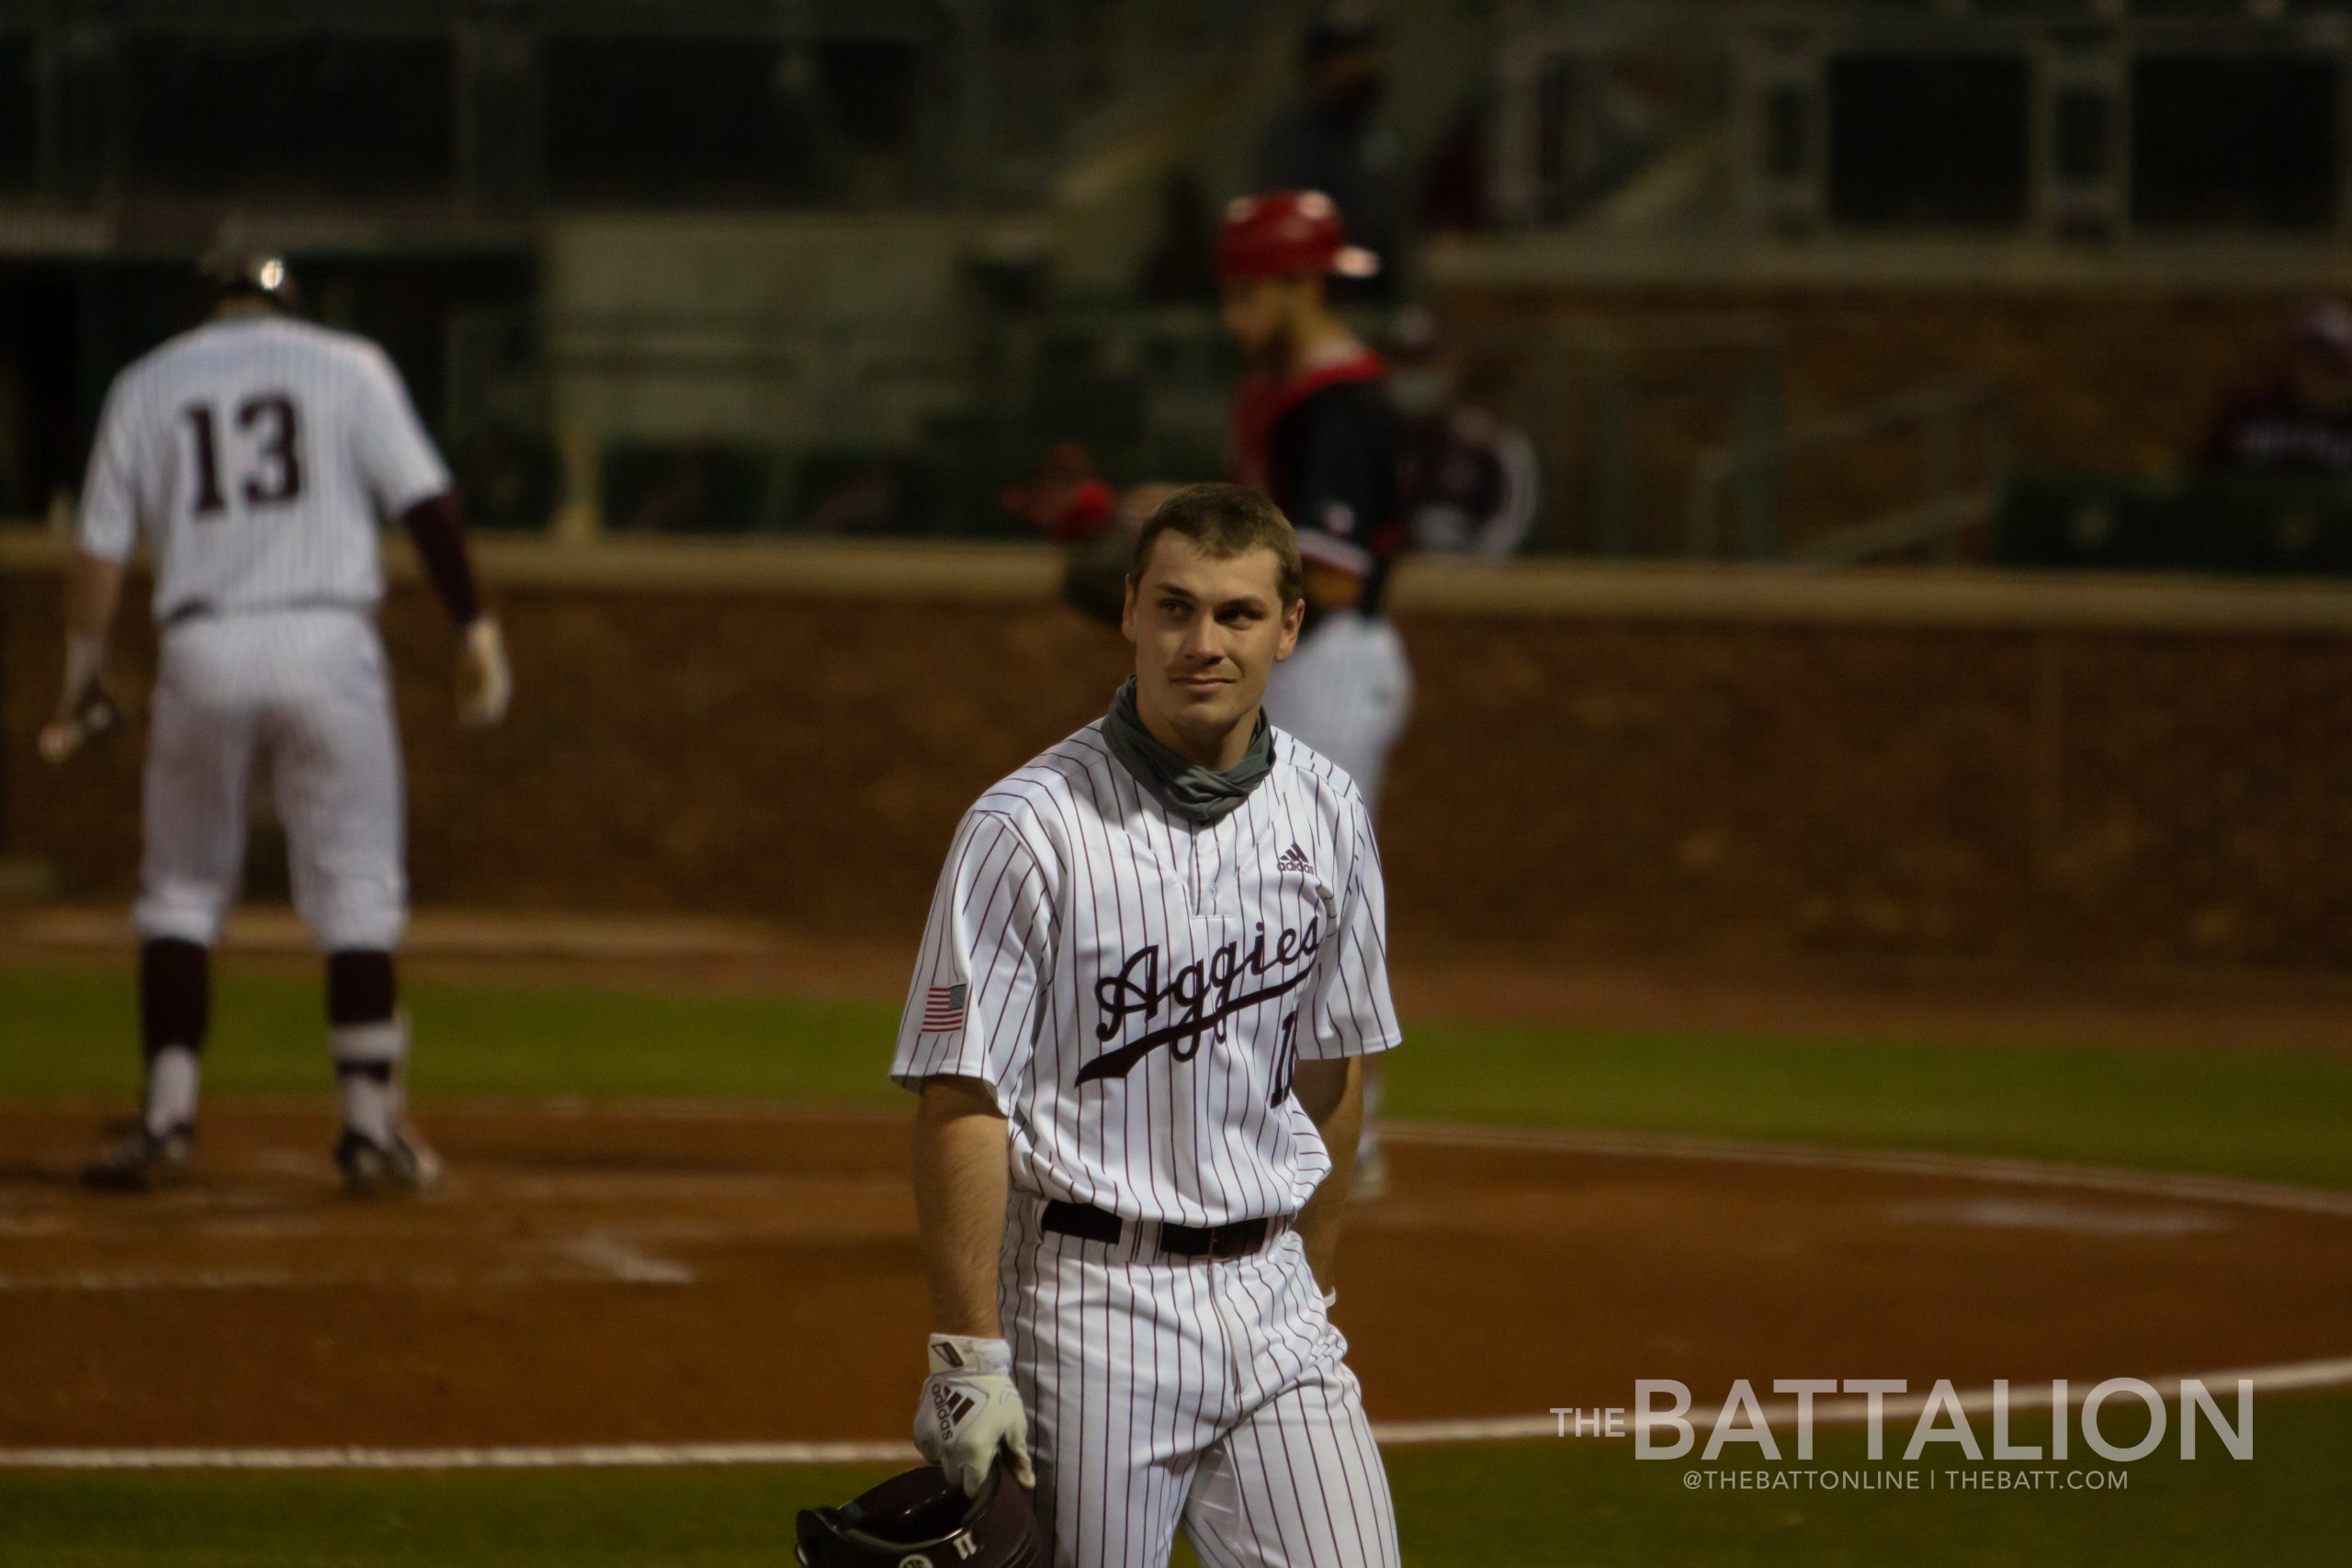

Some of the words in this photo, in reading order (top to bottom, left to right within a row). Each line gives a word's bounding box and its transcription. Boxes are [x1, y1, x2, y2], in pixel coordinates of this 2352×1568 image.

[182, 397, 300, 513] 13
[1277, 861, 1314, 874] adidas
[1095, 916, 1319, 1062] Aggies
[933, 1384, 953, 1440] adidas
